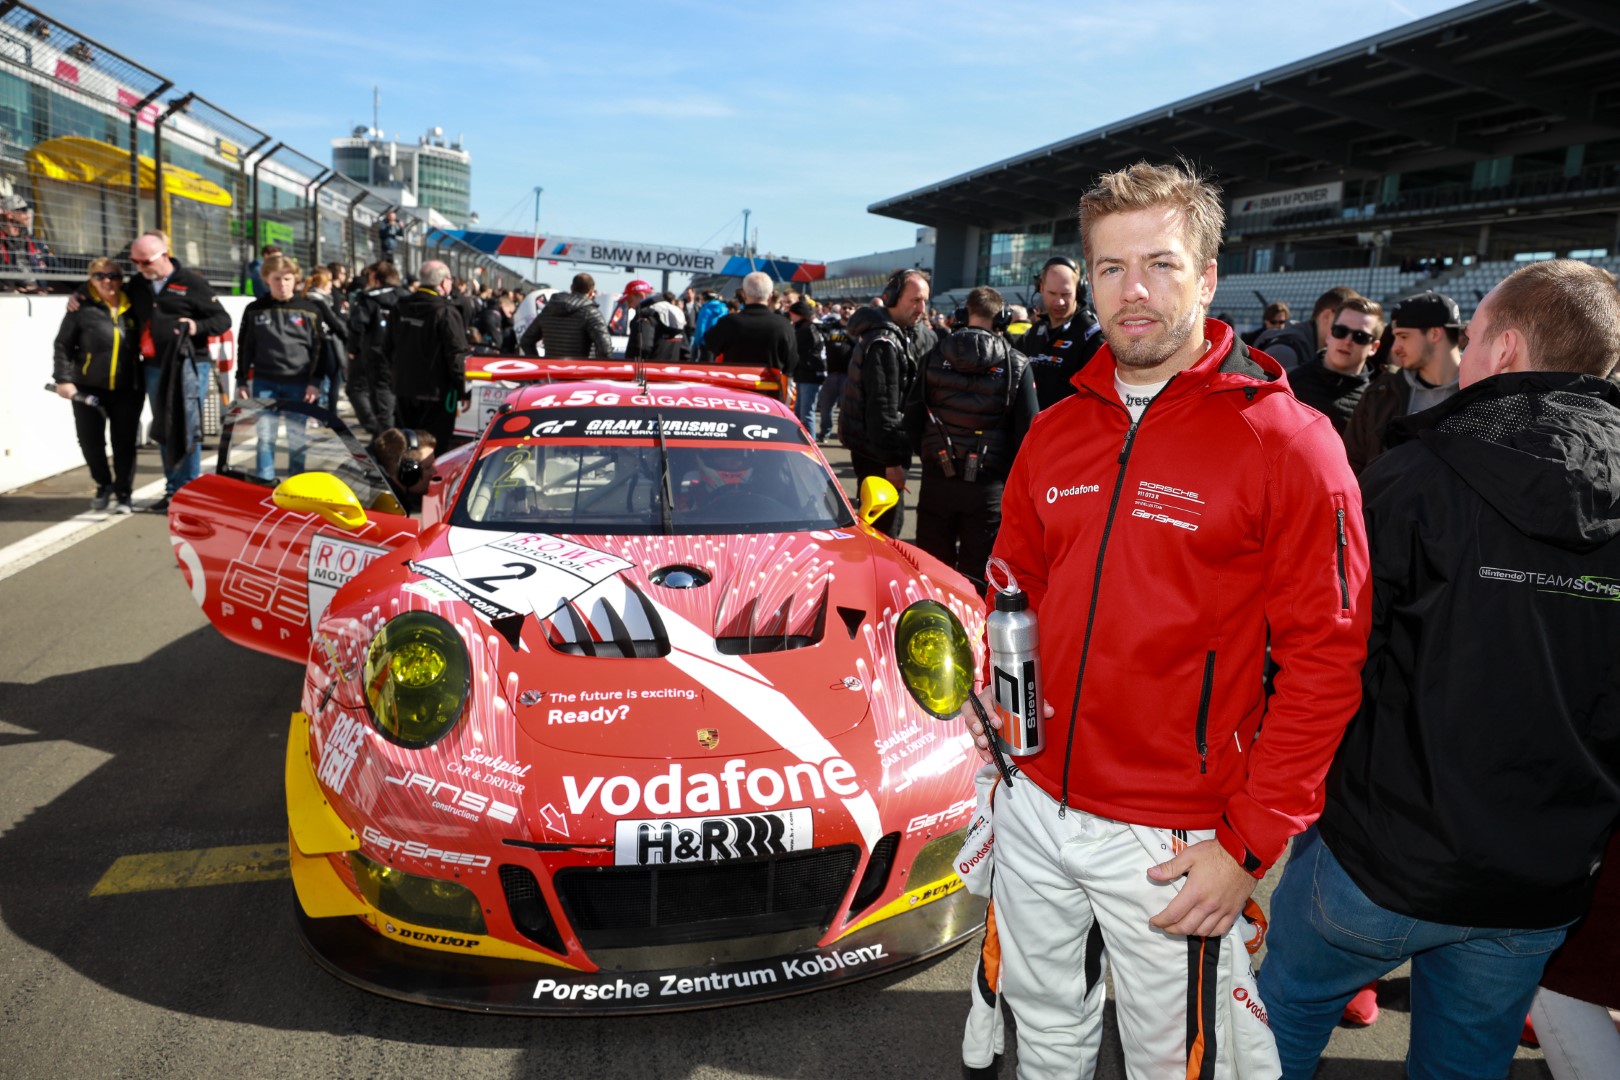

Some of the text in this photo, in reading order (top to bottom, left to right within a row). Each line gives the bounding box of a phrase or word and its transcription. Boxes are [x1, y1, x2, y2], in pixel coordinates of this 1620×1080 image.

[1293, 188, 1328, 204] POWER
[591, 246, 714, 270] BMW M POWER
[531, 390, 770, 414] 4.5G GIGASPEED
[586, 419, 729, 433] GRAN TURISMO
[1060, 484, 1100, 498] vodafone
[1139, 480, 1200, 500] PORSCHE
[499, 541, 587, 572] MOTOR OIL
[512, 534, 615, 568] ROWE
[462, 562, 537, 594] 2
[1480, 568, 1524, 581] Nintendo
[551, 686, 699, 704] The future is exciting.
[1027, 680, 1036, 729] Steve
[547, 704, 630, 725] Ready?
[327, 711, 366, 761] RACE
[874, 720, 921, 755] Senkpiel
[461, 747, 532, 778] Senkpiel
[881, 731, 937, 769] CAR & DRIVER
[317, 743, 355, 795] TAXI
[447, 761, 526, 795] CAR & DRIVER
[562, 757, 860, 817] vodafone
[431, 800, 480, 822] constructions
[920, 878, 962, 901] DUNL
[398, 928, 480, 948] DUNLOP
[533, 942, 888, 1001] Porsche Zentrum Koblenz
